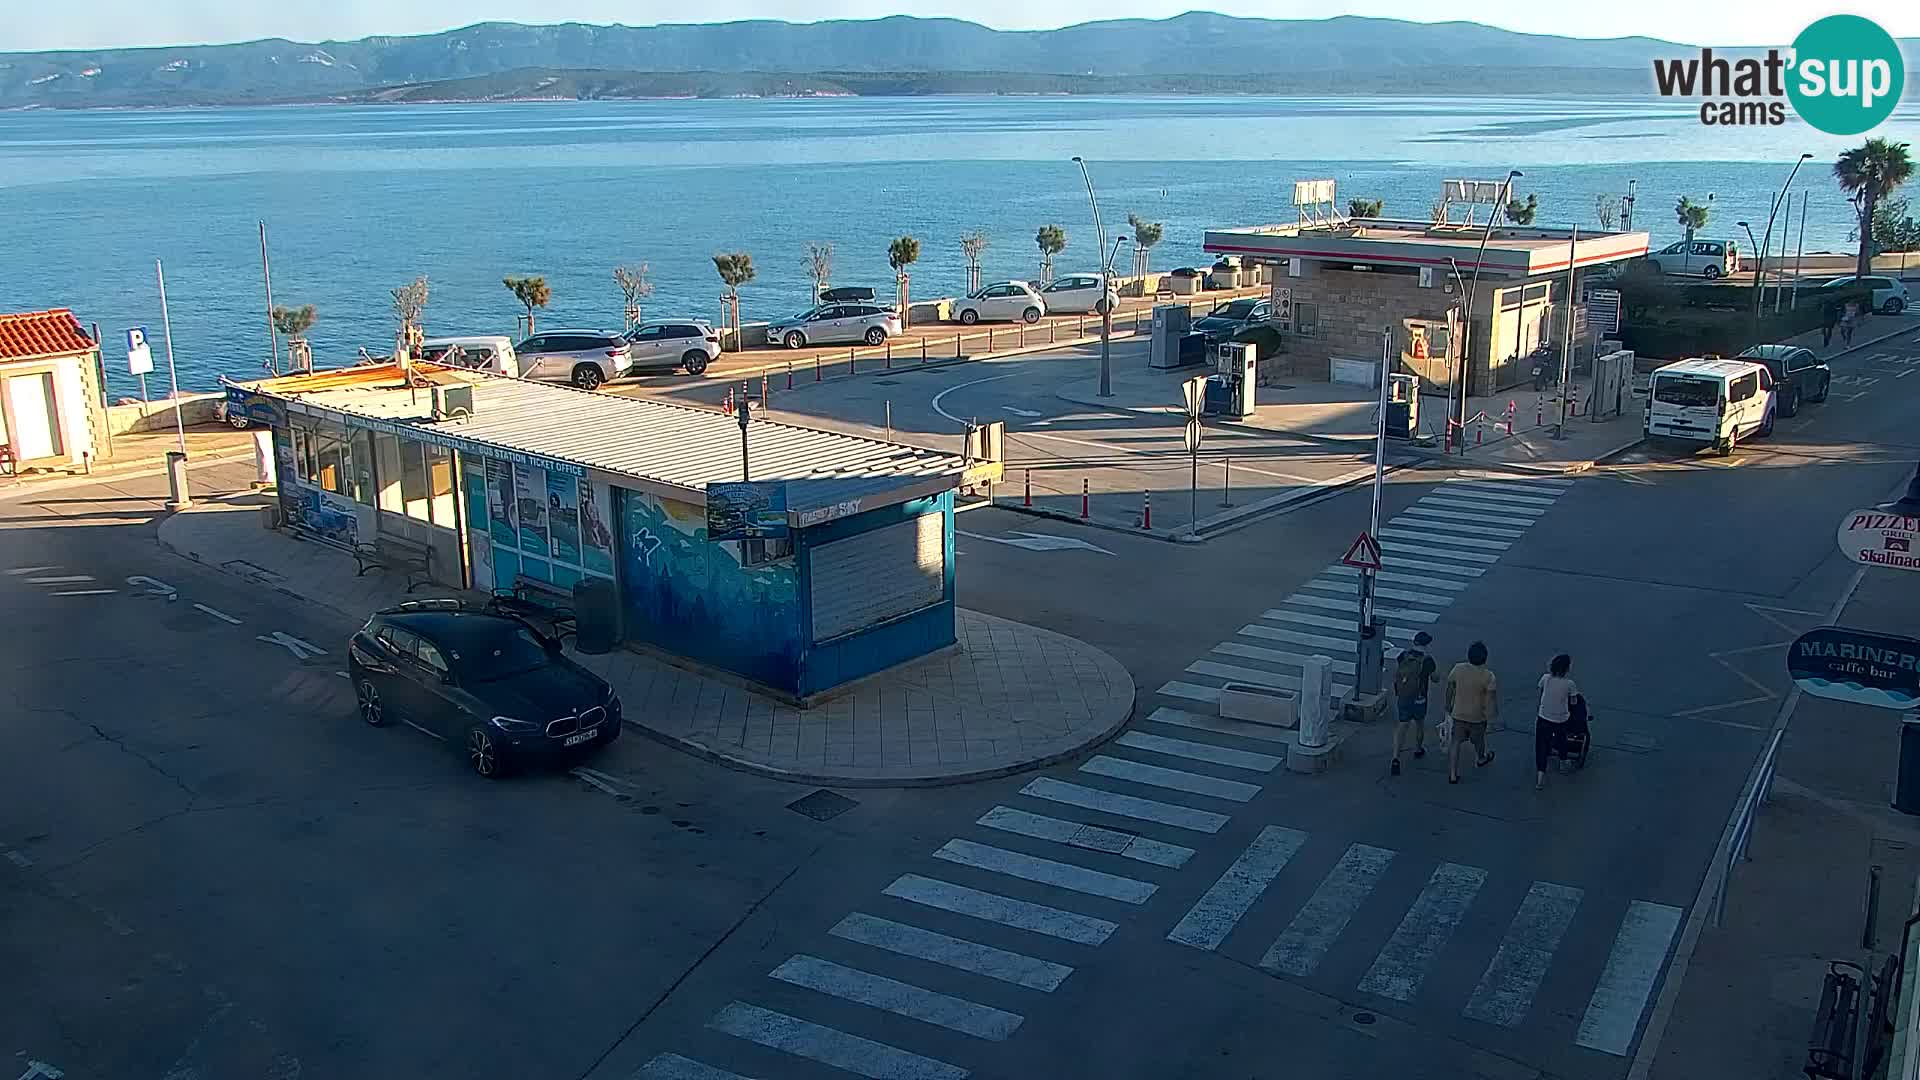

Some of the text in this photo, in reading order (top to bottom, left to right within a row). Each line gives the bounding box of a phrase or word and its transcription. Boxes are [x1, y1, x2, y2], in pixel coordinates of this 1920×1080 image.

[130, 329, 145, 350] P
[437, 436, 468, 450] POSTAJA
[478, 446, 583, 476] BUS STATION TICKET OFFICE
[1881, 529, 1914, 539] GRILL
[1828, 661, 1897, 679] caffe bar
